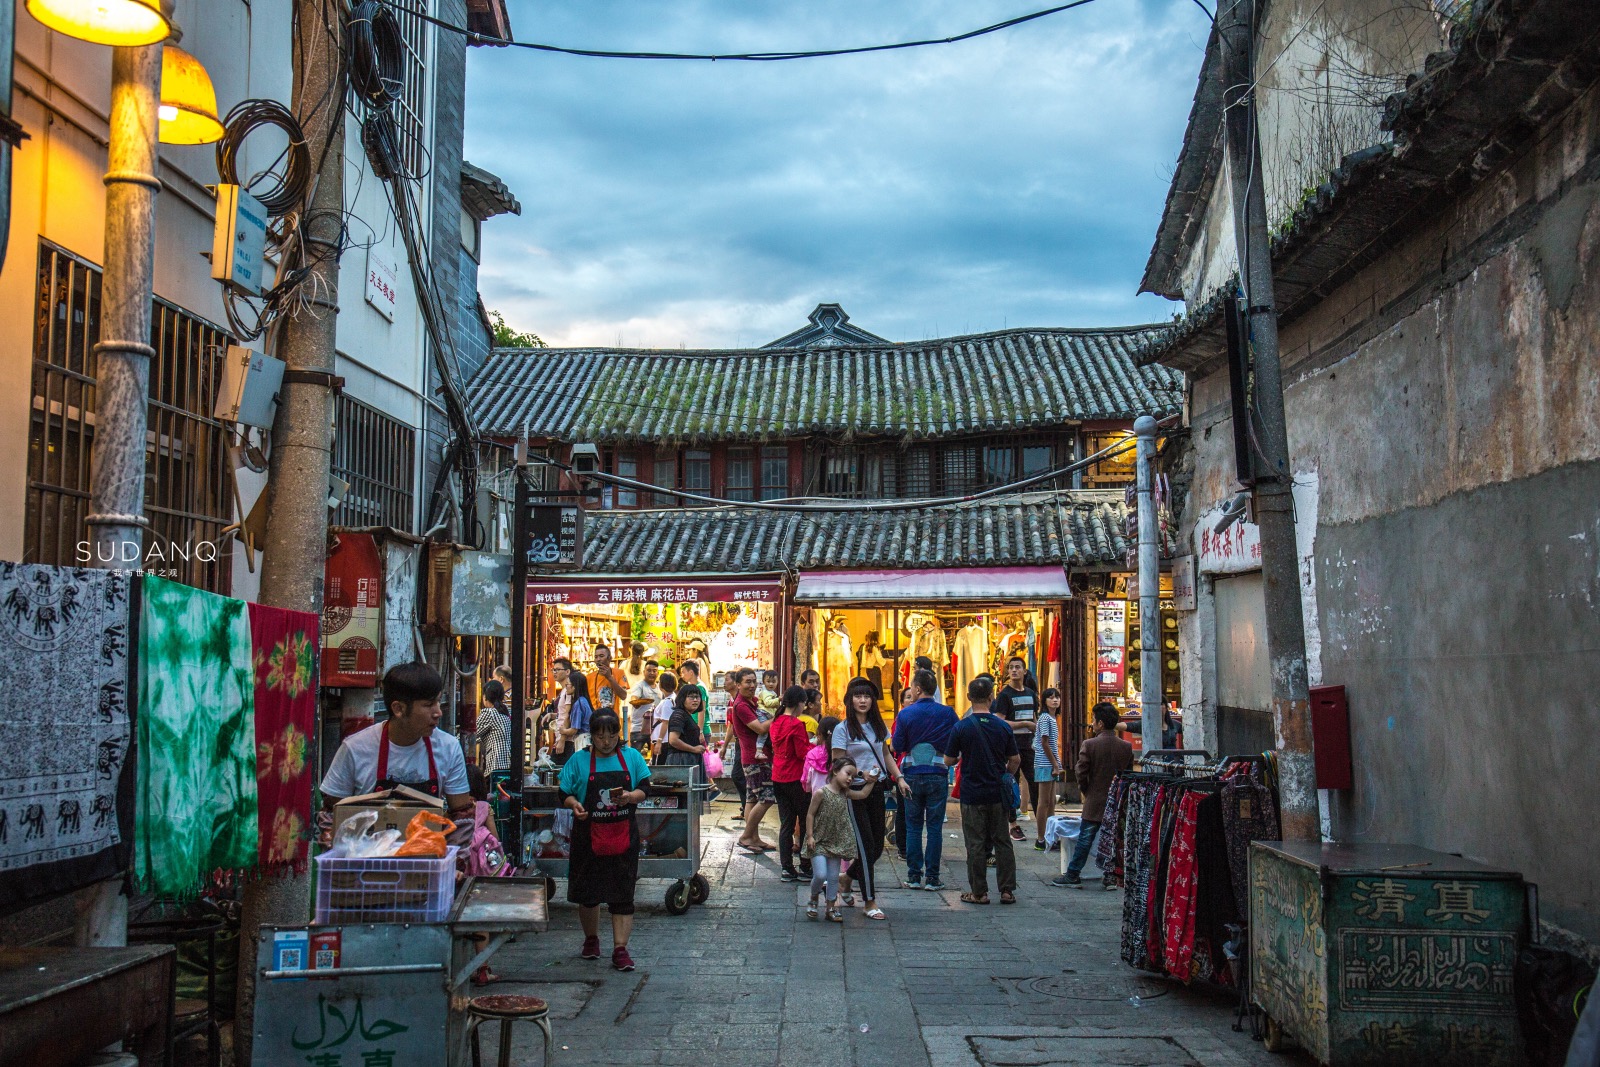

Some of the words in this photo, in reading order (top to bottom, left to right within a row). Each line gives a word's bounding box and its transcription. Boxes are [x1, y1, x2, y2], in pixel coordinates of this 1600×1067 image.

[536, 593, 569, 602] 解忧铺子
[598, 589, 647, 602] 云南杂粮
[650, 588, 698, 602] 麻花总店
[734, 590, 769, 600] 解忧铺子
[1352, 878, 1491, 923] 清真
